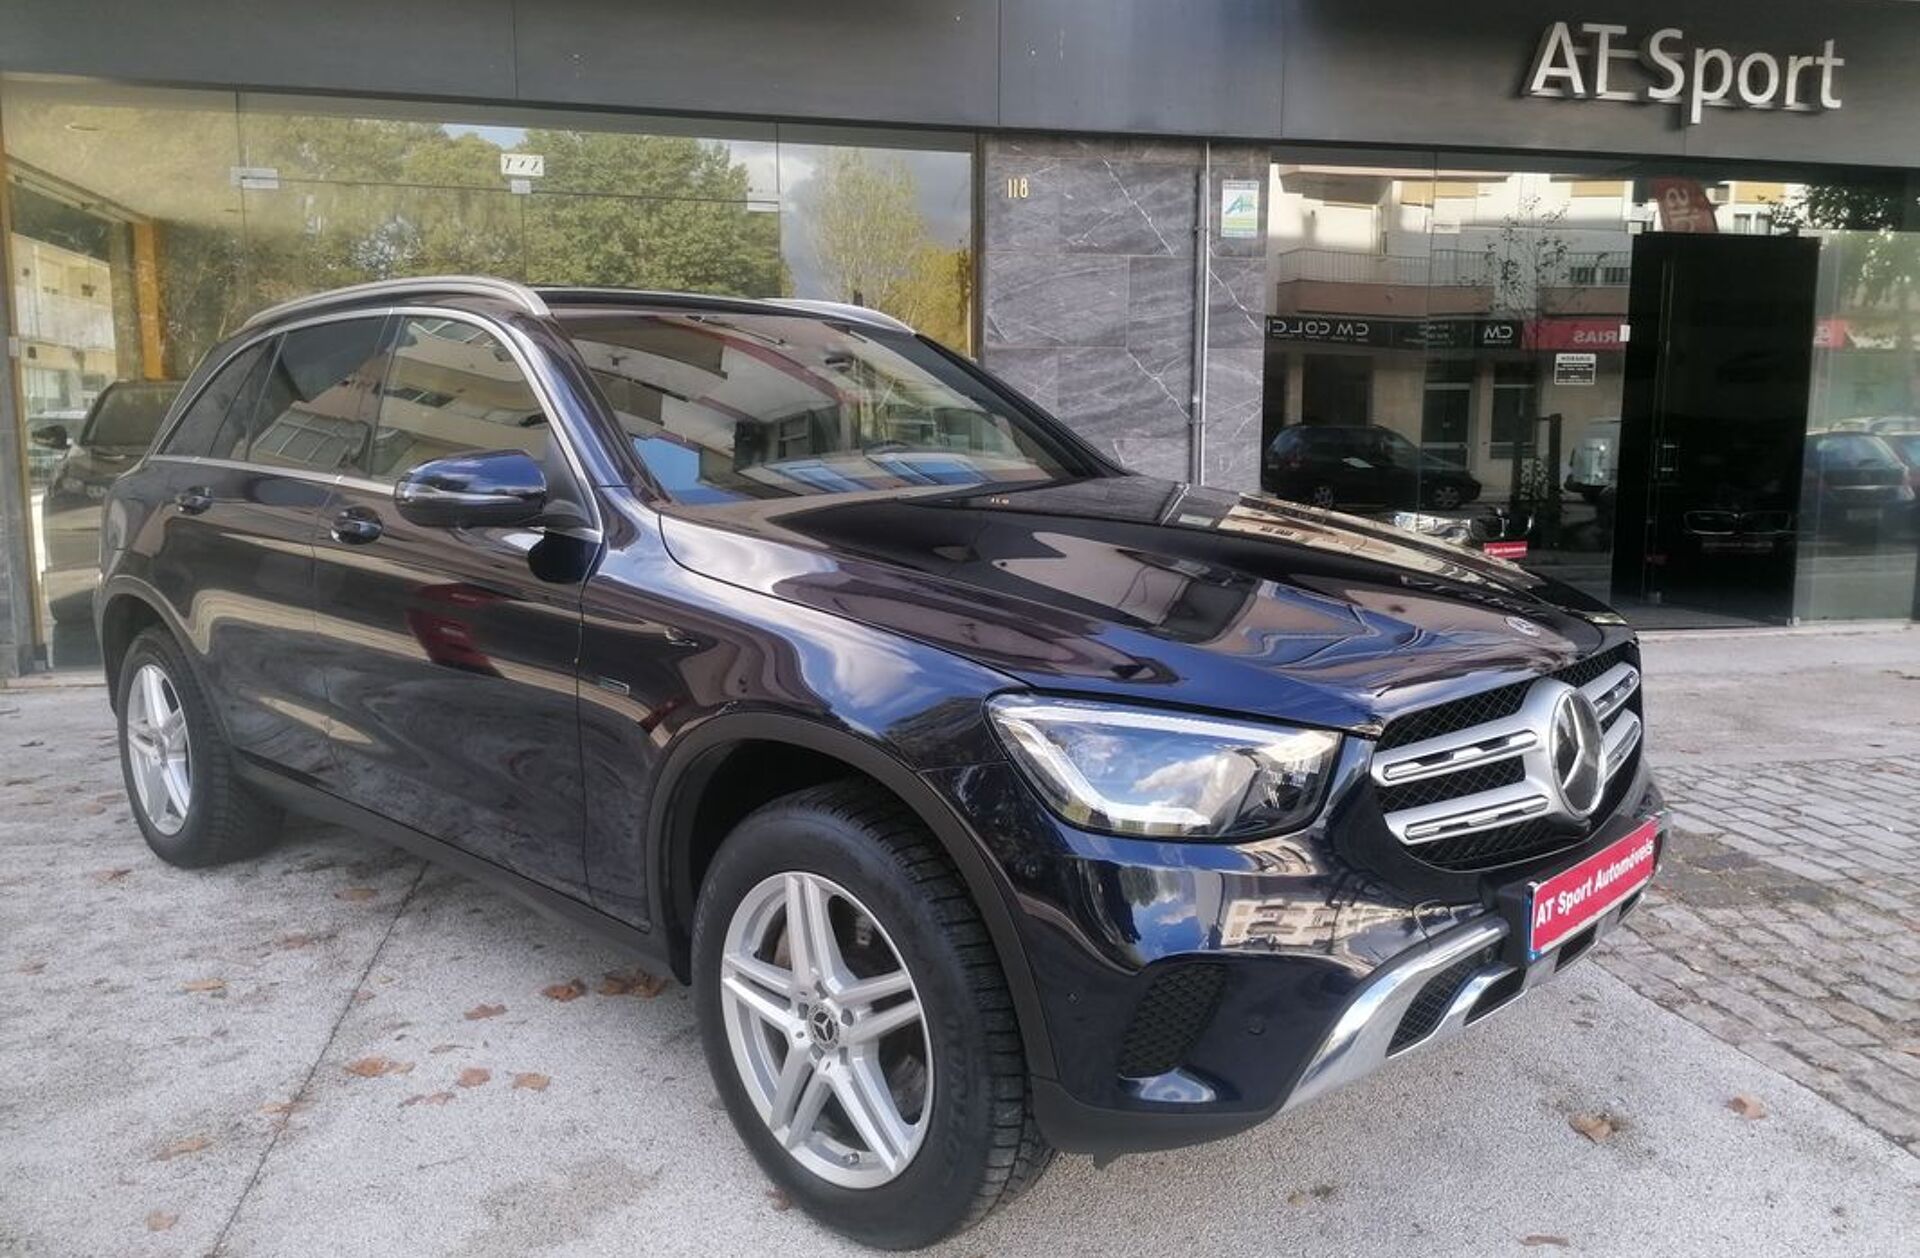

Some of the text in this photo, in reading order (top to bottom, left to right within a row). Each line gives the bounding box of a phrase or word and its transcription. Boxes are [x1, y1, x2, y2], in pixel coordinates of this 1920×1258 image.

[1530, 22, 1845, 125] AT Sport
[1007, 178, 1029, 199] 118
[1535, 898, 1556, 928] AT
[1557, 877, 1592, 915] Sport
